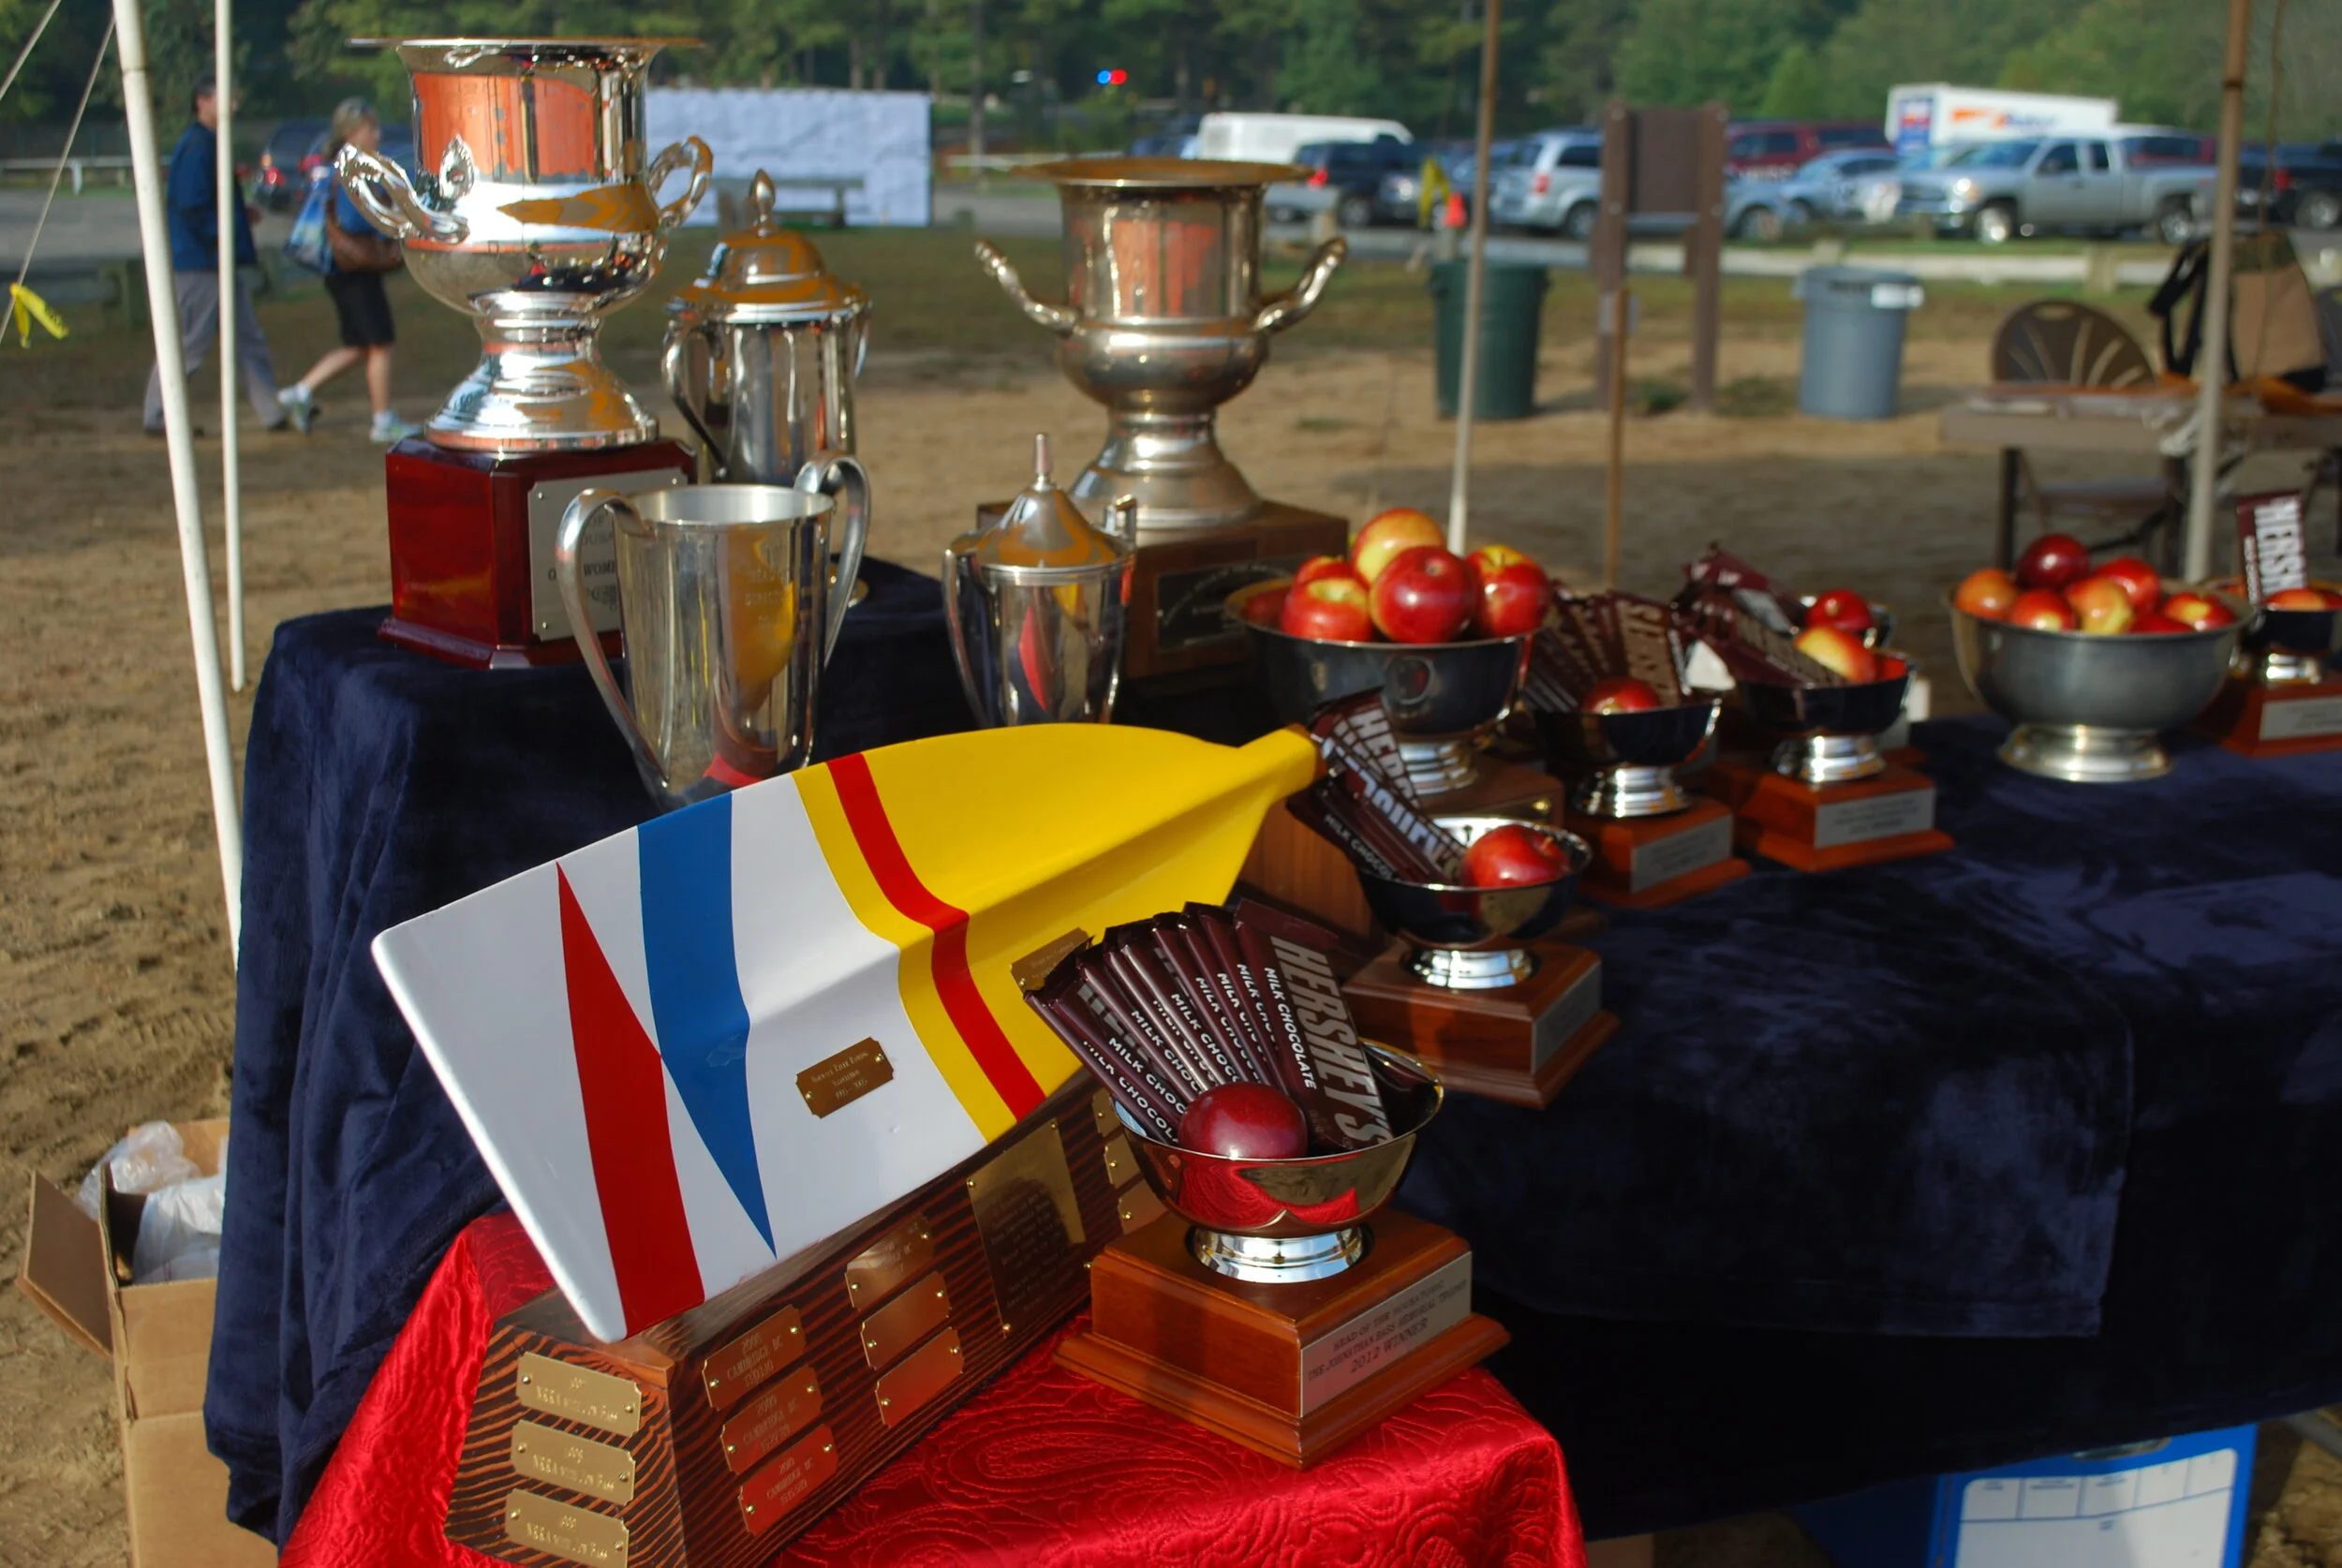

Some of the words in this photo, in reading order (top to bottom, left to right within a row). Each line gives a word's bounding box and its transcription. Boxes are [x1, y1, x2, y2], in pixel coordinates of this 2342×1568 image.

[1131, 1010, 1164, 1047] MILK
[1171, 993, 1202, 1031] MILK
[1264, 967, 1286, 1001] MILK
[1277, 1002, 1318, 1090] CHOCOLATE
[1270, 936, 1394, 1145] HERSHEY'S
[1108, 1037, 1145, 1073] MILK
[1118, 1076, 1179, 1144] CHOCOL
[1350, 1345, 1381, 1374] 2012
[1383, 1316, 1429, 1354] WINNER
